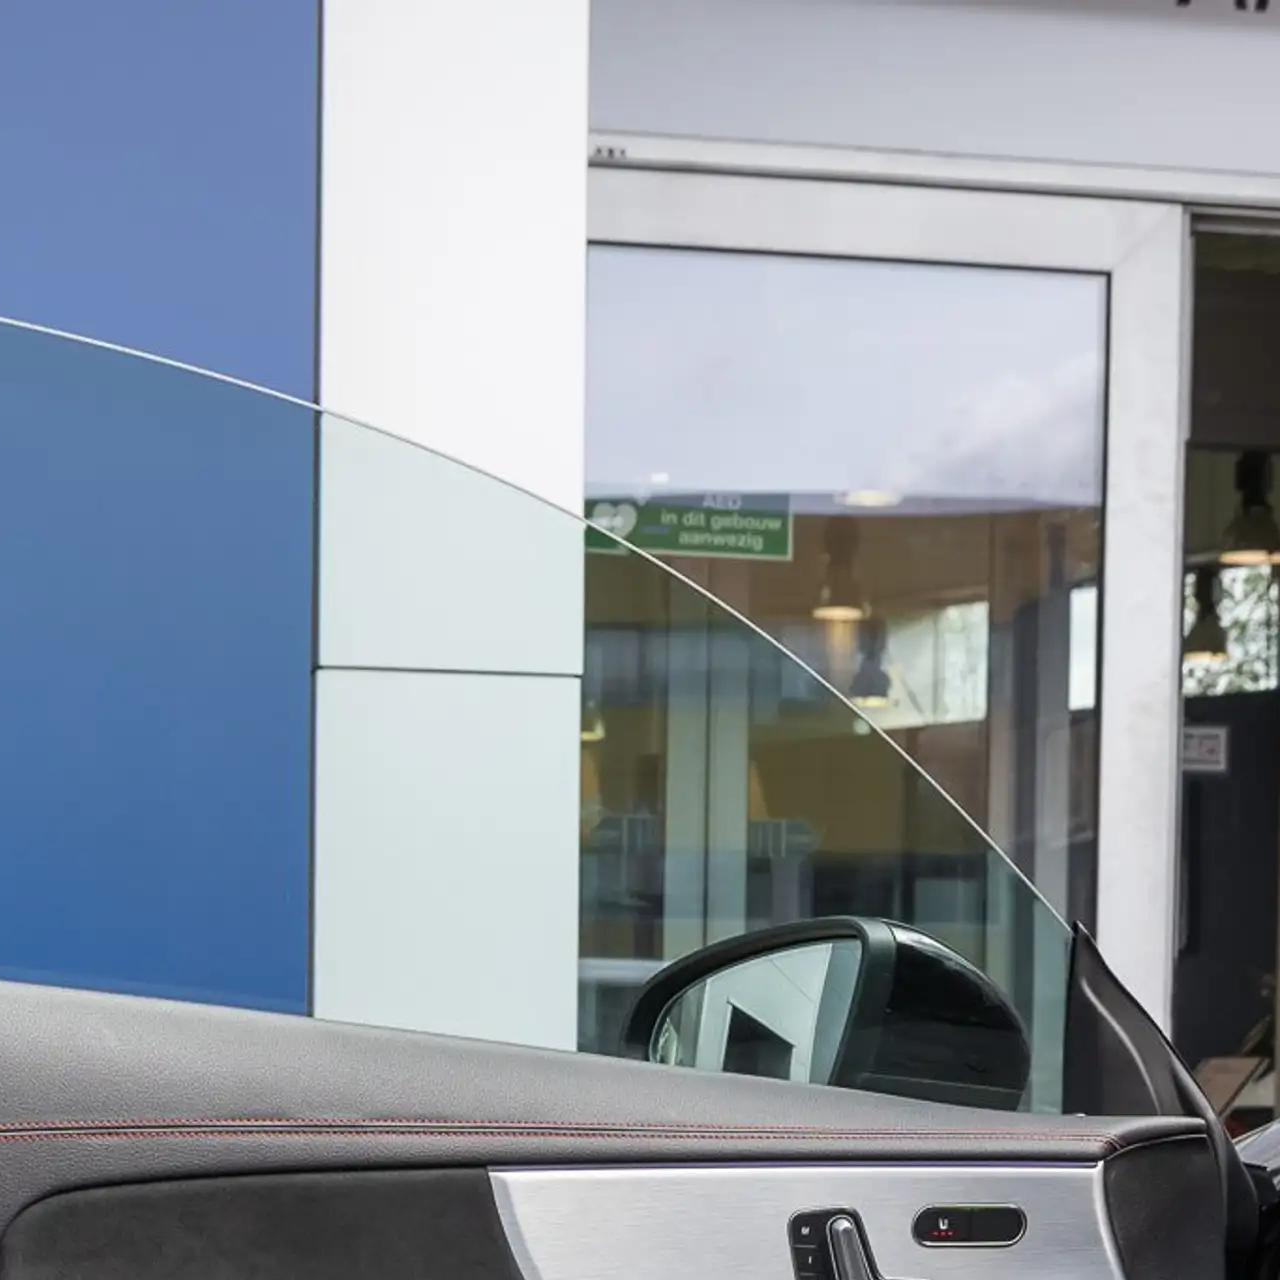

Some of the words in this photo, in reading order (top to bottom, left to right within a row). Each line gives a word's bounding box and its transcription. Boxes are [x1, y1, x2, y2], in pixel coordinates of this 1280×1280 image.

[702, 492, 743, 510] AED
[661, 508, 677, 525] in
[682, 510, 705, 527] dit
[711, 512, 782, 531] gebouw
[679, 531, 764, 551] aanwezig
